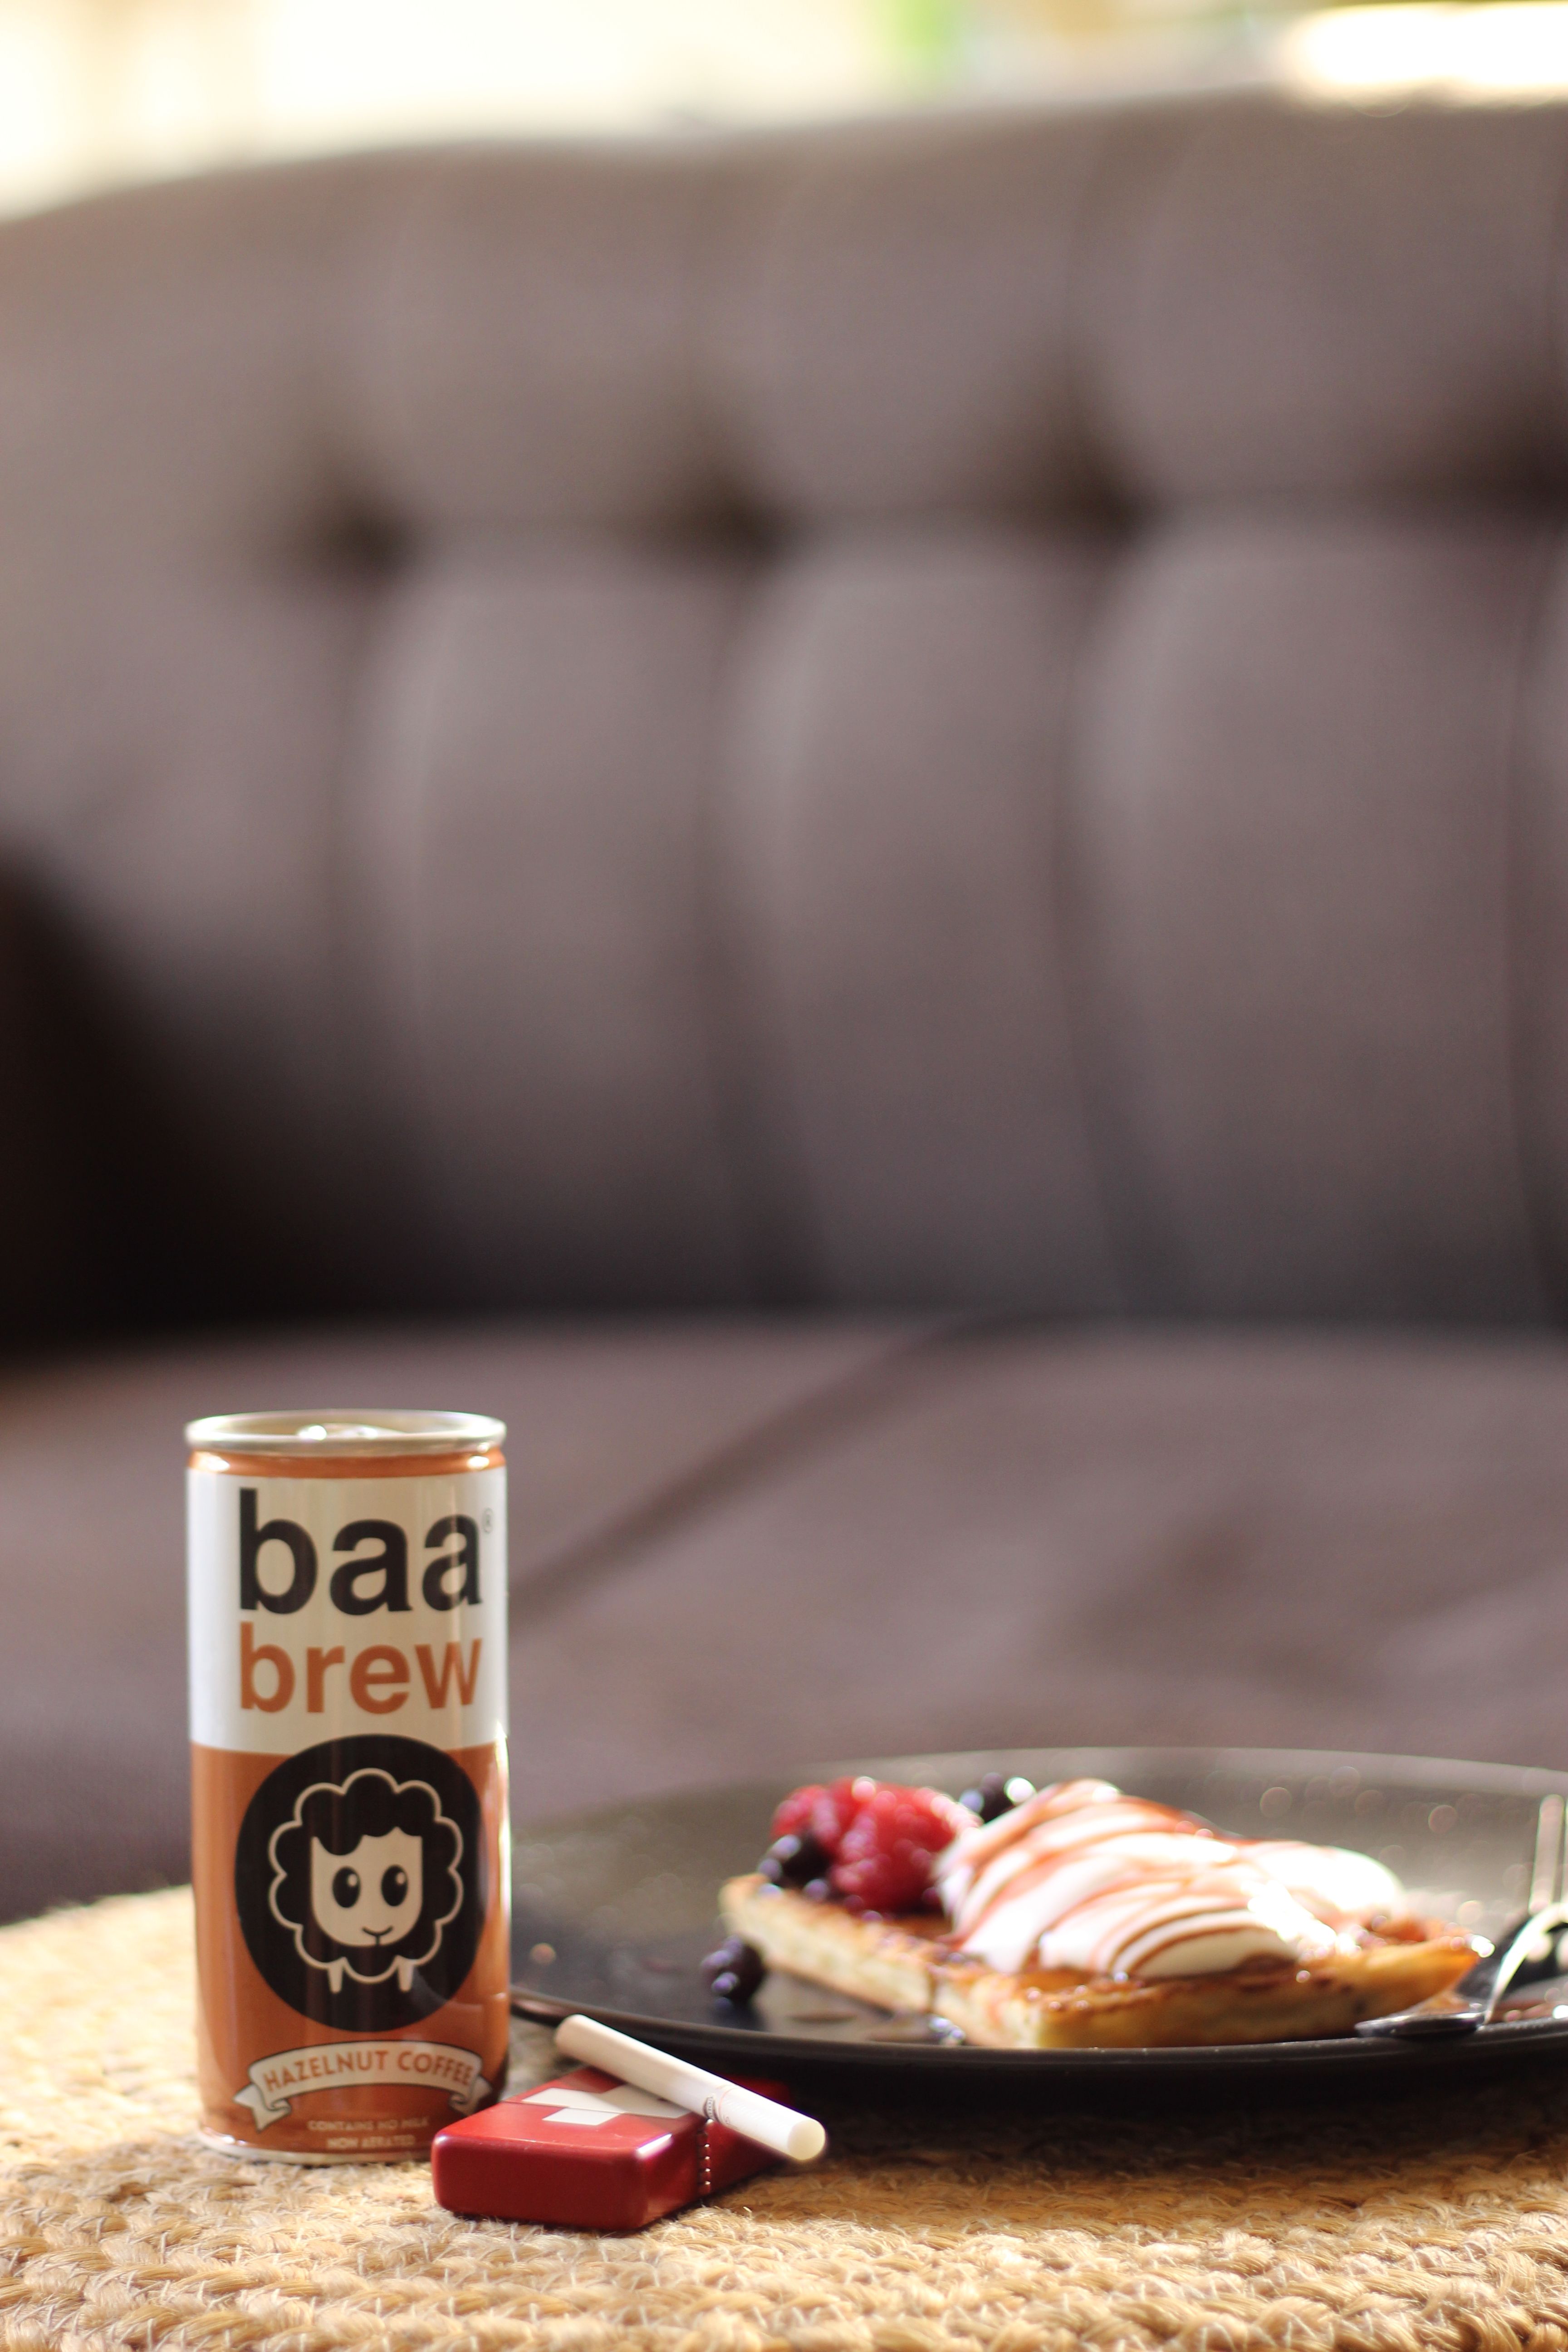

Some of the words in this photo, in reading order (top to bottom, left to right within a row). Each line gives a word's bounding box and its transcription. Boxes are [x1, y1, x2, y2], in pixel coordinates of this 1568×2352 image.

[239, 1487, 483, 1616] baa
[240, 1622, 482, 1714] brew
[263, 2051, 388, 2092] HAZELNUT
[397, 2051, 474, 2086] COFFEE
